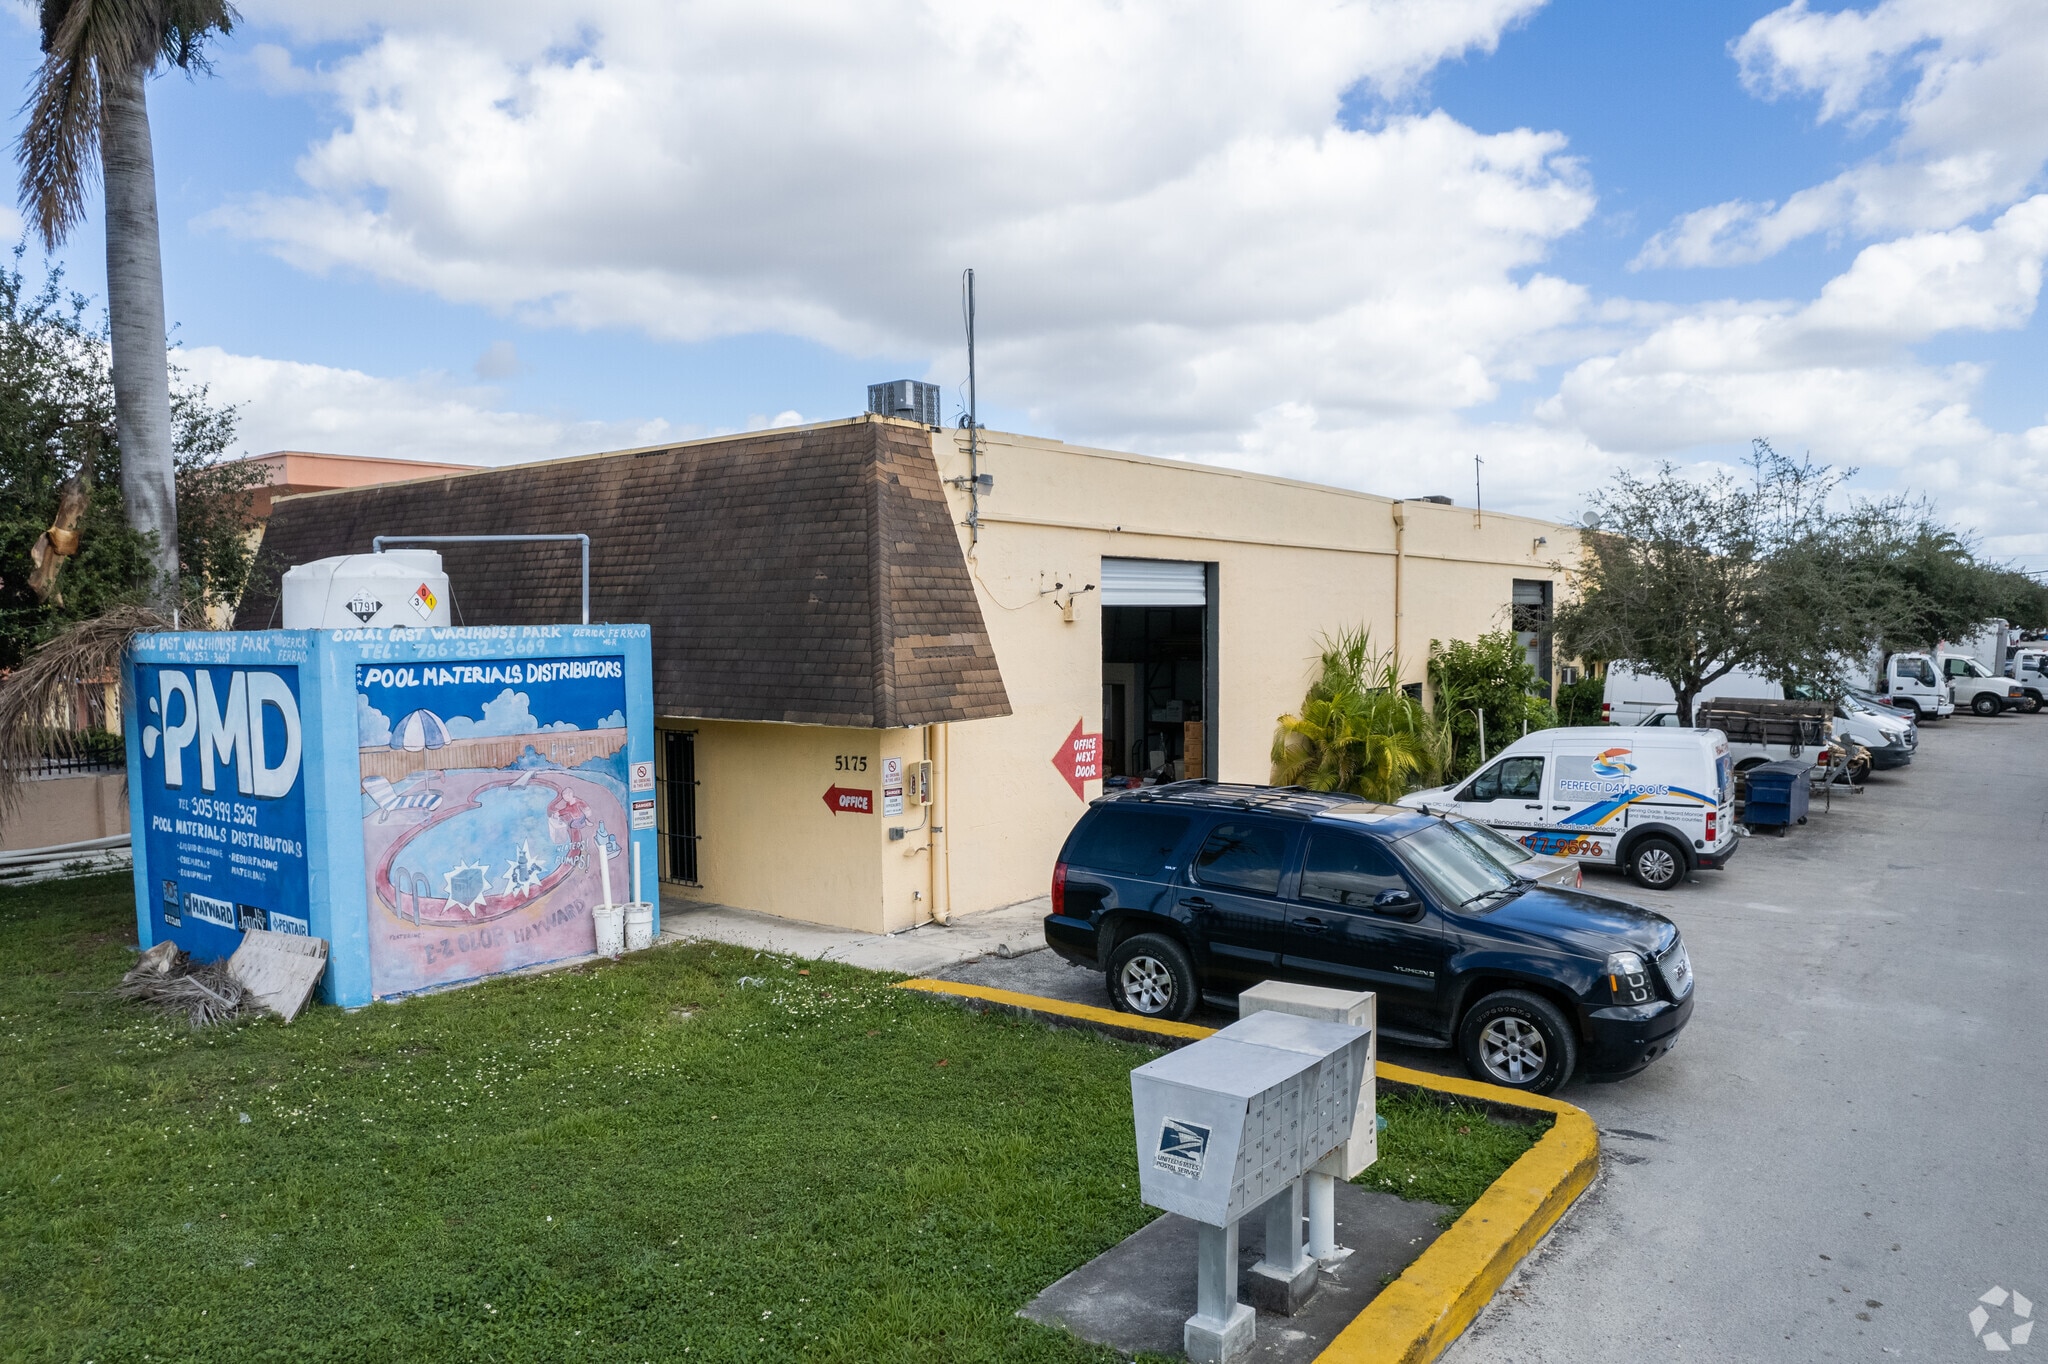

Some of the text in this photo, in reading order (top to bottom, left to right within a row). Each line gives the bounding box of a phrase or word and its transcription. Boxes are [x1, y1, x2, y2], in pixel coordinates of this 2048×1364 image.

[421, 588, 427, 597] 0
[353, 602, 376, 612] 1791
[414, 598, 420, 606] 3
[332, 626, 562, 642] DORAL EAST WAREHOUSE PARK
[572, 628, 647, 638] DERICK FERRAO
[159, 637, 180, 651] EAST
[183, 636, 237, 652] WAREHOUSE
[241, 635, 271, 654] PARK
[358, 643, 400, 660] TEL:
[277, 650, 307, 663] FERRAO
[364, 660, 622, 688] POOL MATERIALS DISTRIBUTORS
[159, 669, 301, 798] PMD
[1073, 737, 1097, 751] OFFICE
[835, 754, 868, 772] 5175
[1075, 750, 1096, 763] NEXT
[1074, 764, 1097, 778] DOOR
[1560, 780, 1670, 796] PERFECT DAY POOLS
[838, 794, 868, 810] OFFICE
[152, 815, 303, 858] POOL MATERIALS DISTRIBUTORS
[180, 855, 211, 869] CHEMICALS
[231, 852, 279, 872] RESURFACING
[554, 854, 591, 873] PUMPS!
[180, 868, 212, 882] EQUIPMENT
[231, 866, 266, 882] MATERIALS
[192, 896, 234, 925] HAYWARD
[279, 919, 308, 937] PENTAIR
[513, 899, 588, 944] HAYWARD
[1393, 965, 1429, 976] YUKON
[1156, 1160, 1201, 1178] POSTAL SERVICE
[1157, 1154, 1200, 1171] UNITED STATES
